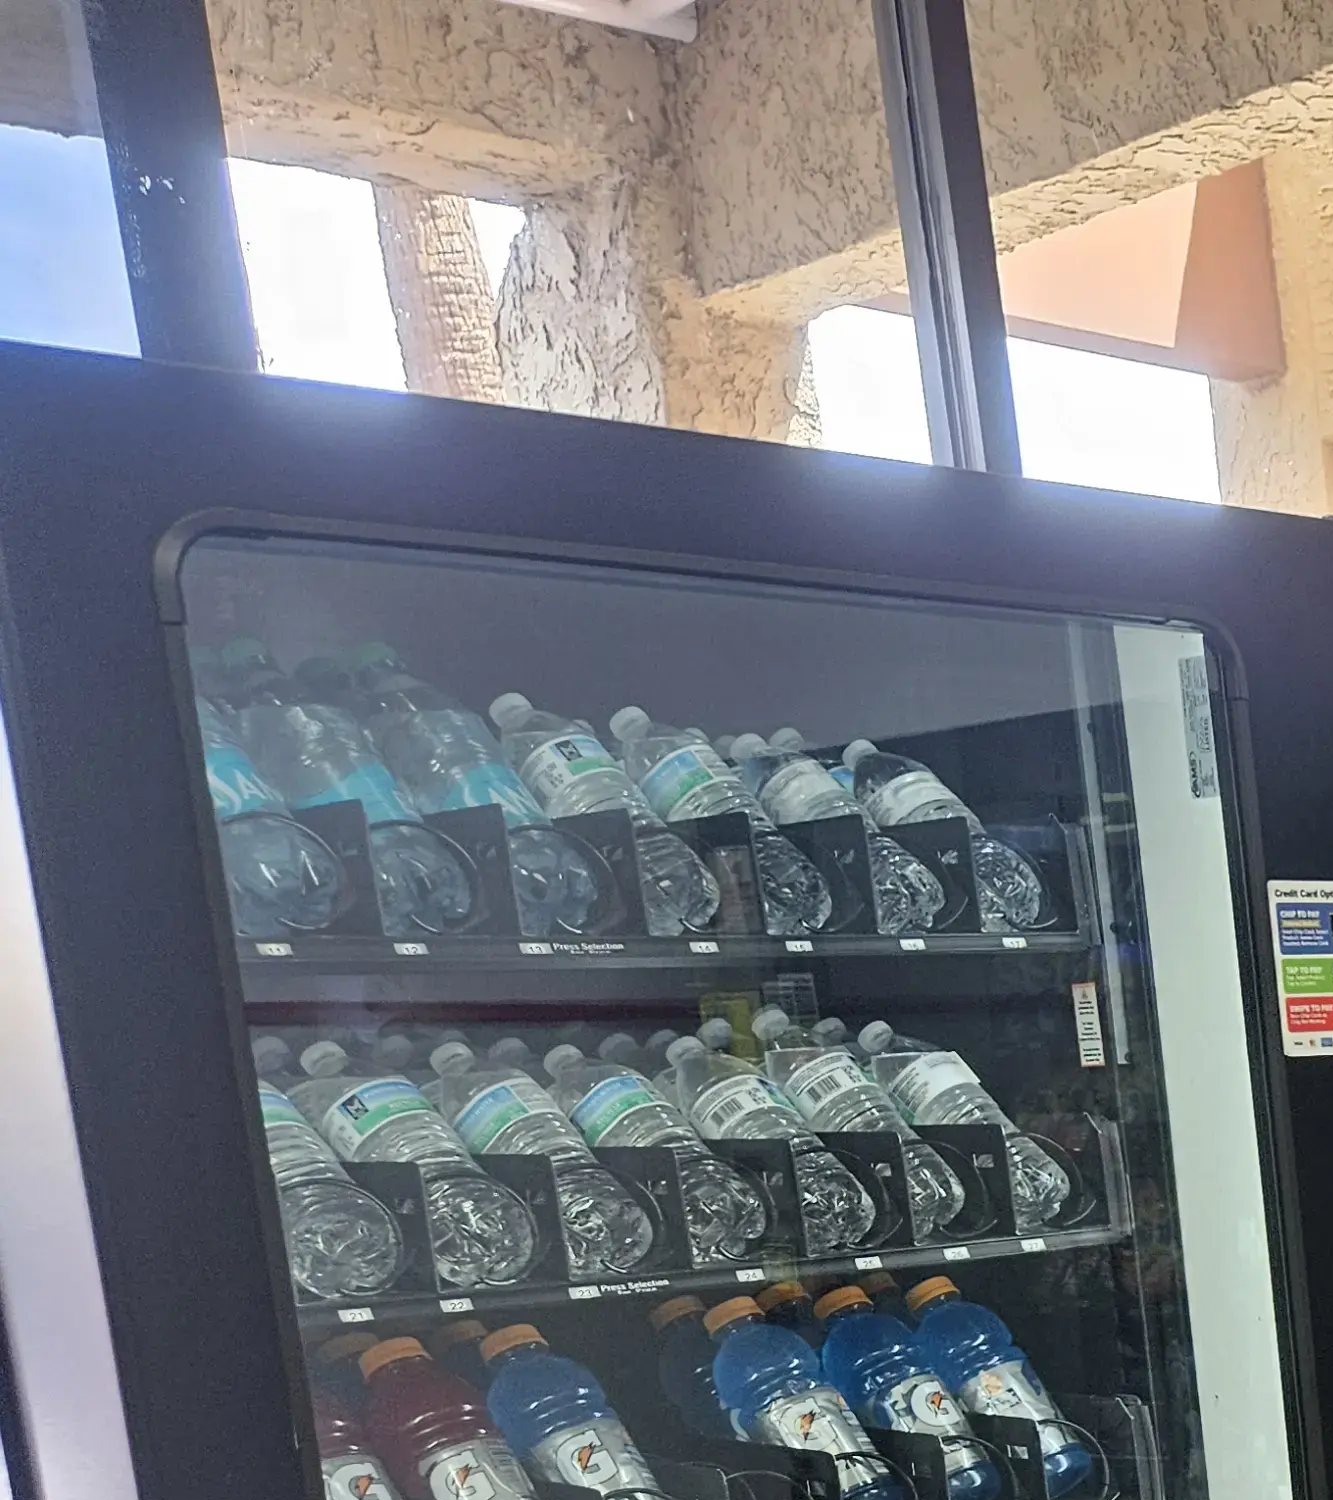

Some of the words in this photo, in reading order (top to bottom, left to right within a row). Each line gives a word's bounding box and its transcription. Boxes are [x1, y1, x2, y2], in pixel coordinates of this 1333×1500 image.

[1274, 889, 1298, 899] Credit
[1300, 890, 1318, 899] Card
[553, 942, 580, 950] Press
[581, 942, 624, 951] Selection
[745, 1271, 757, 1279] 24
[600, 1284, 627, 1293] Press
[629, 1280, 670, 1290] Selection
[578, 1289, 592, 1297] 23
[450, 1302, 463, 1310] 22
[350, 1312, 363, 1320] 21
